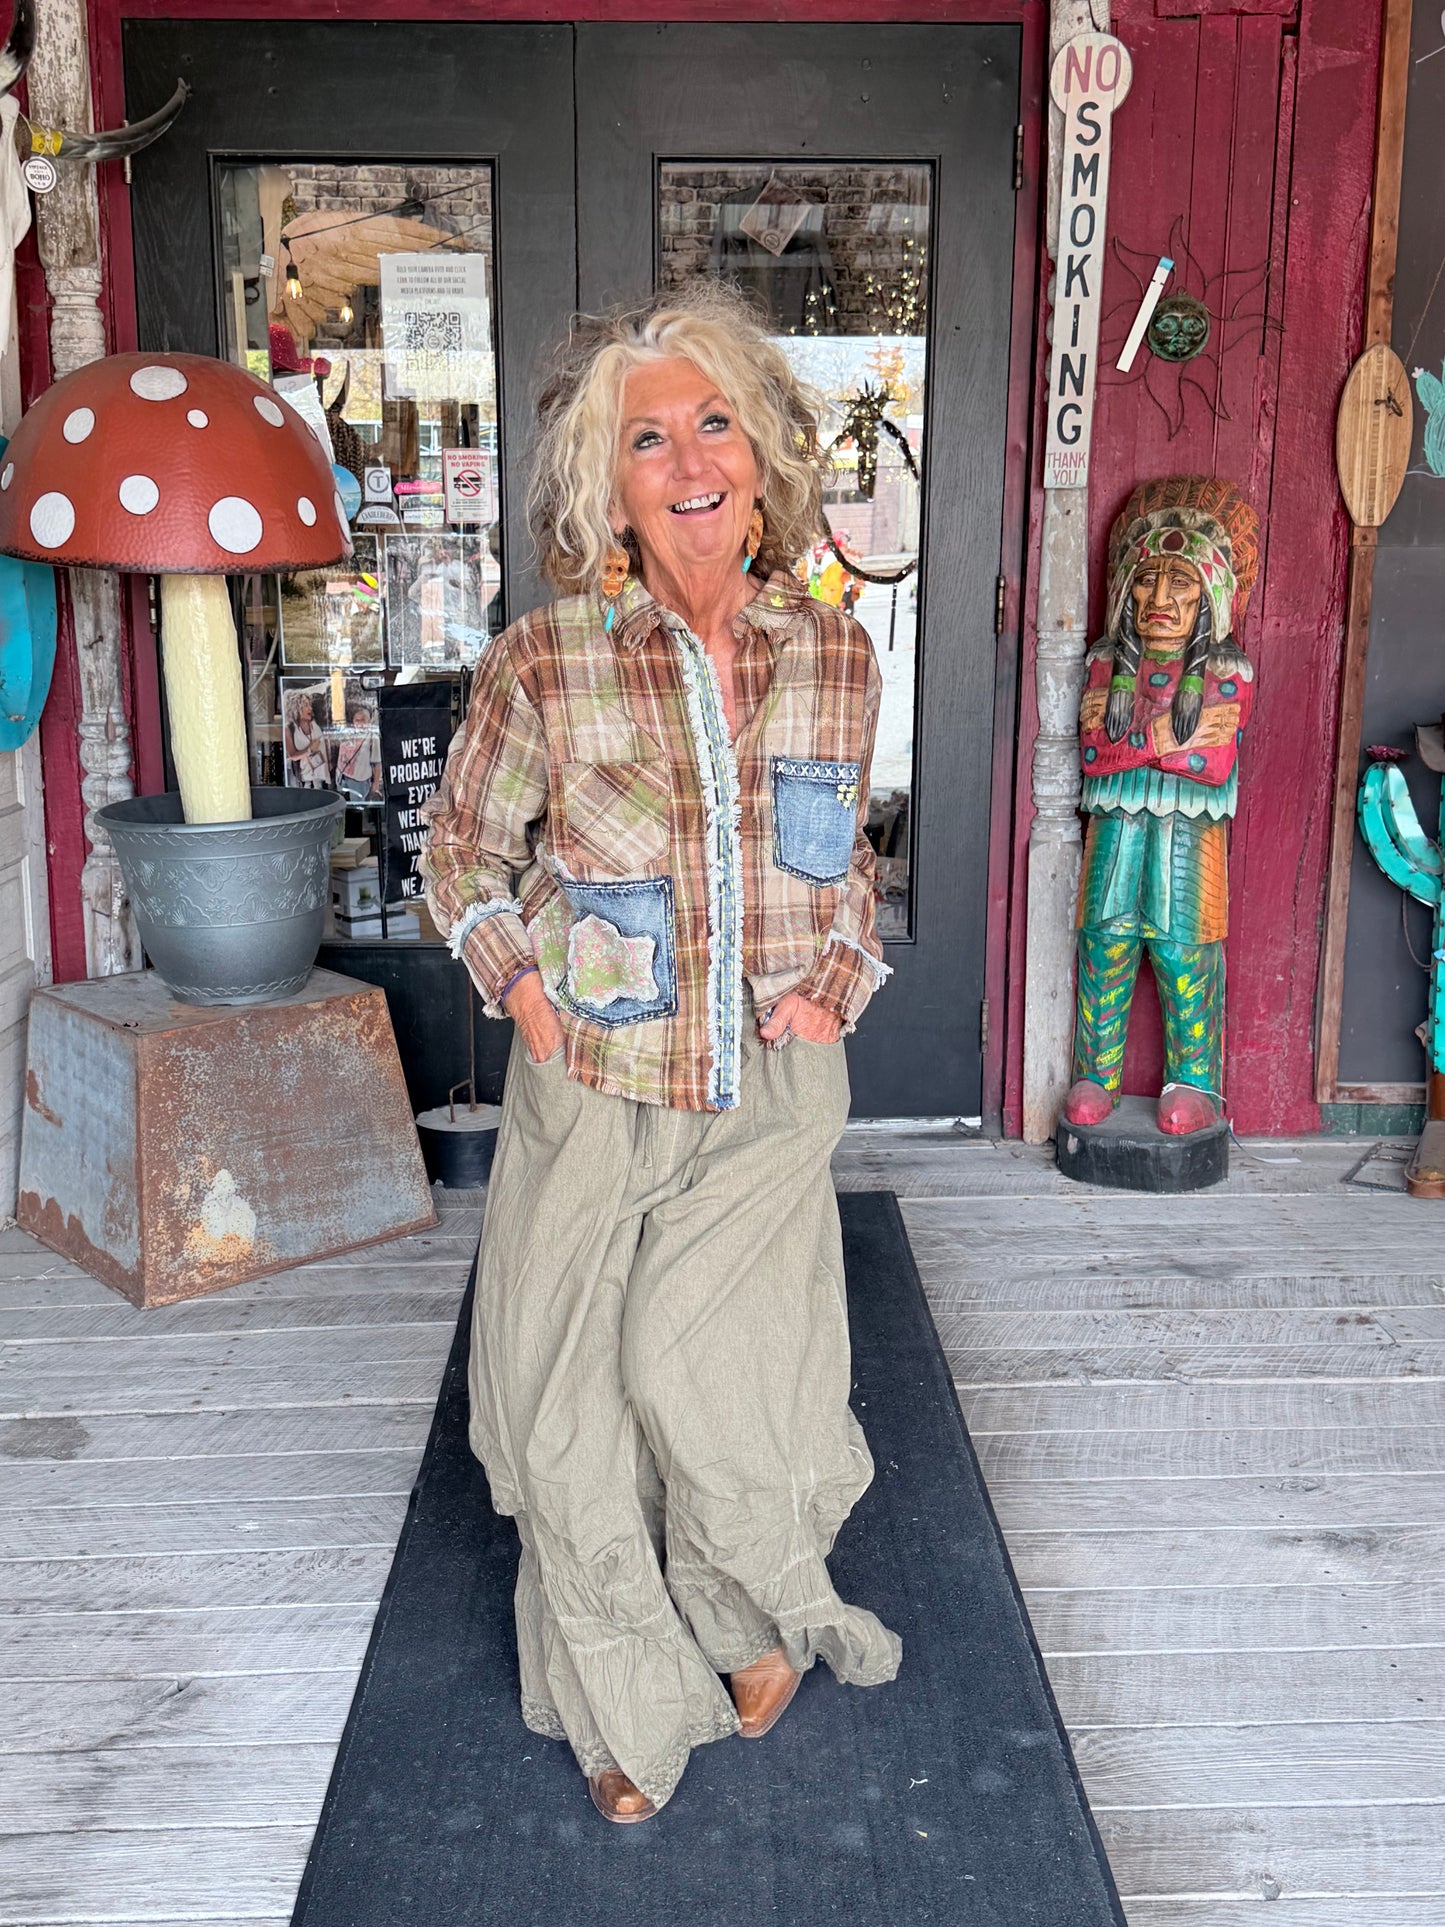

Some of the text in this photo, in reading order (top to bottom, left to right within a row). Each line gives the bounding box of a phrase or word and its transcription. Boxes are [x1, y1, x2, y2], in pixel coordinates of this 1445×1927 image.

[1064, 45, 1121, 93] NO
[1057, 101, 1101, 445] SMOKING
[1046, 452, 1086, 468] THANK
[1053, 469, 1078, 486] YOU
[401, 736, 436, 759] WE'RE
[389, 757, 444, 784] PROBABLY
[401, 876, 417, 897] WE
